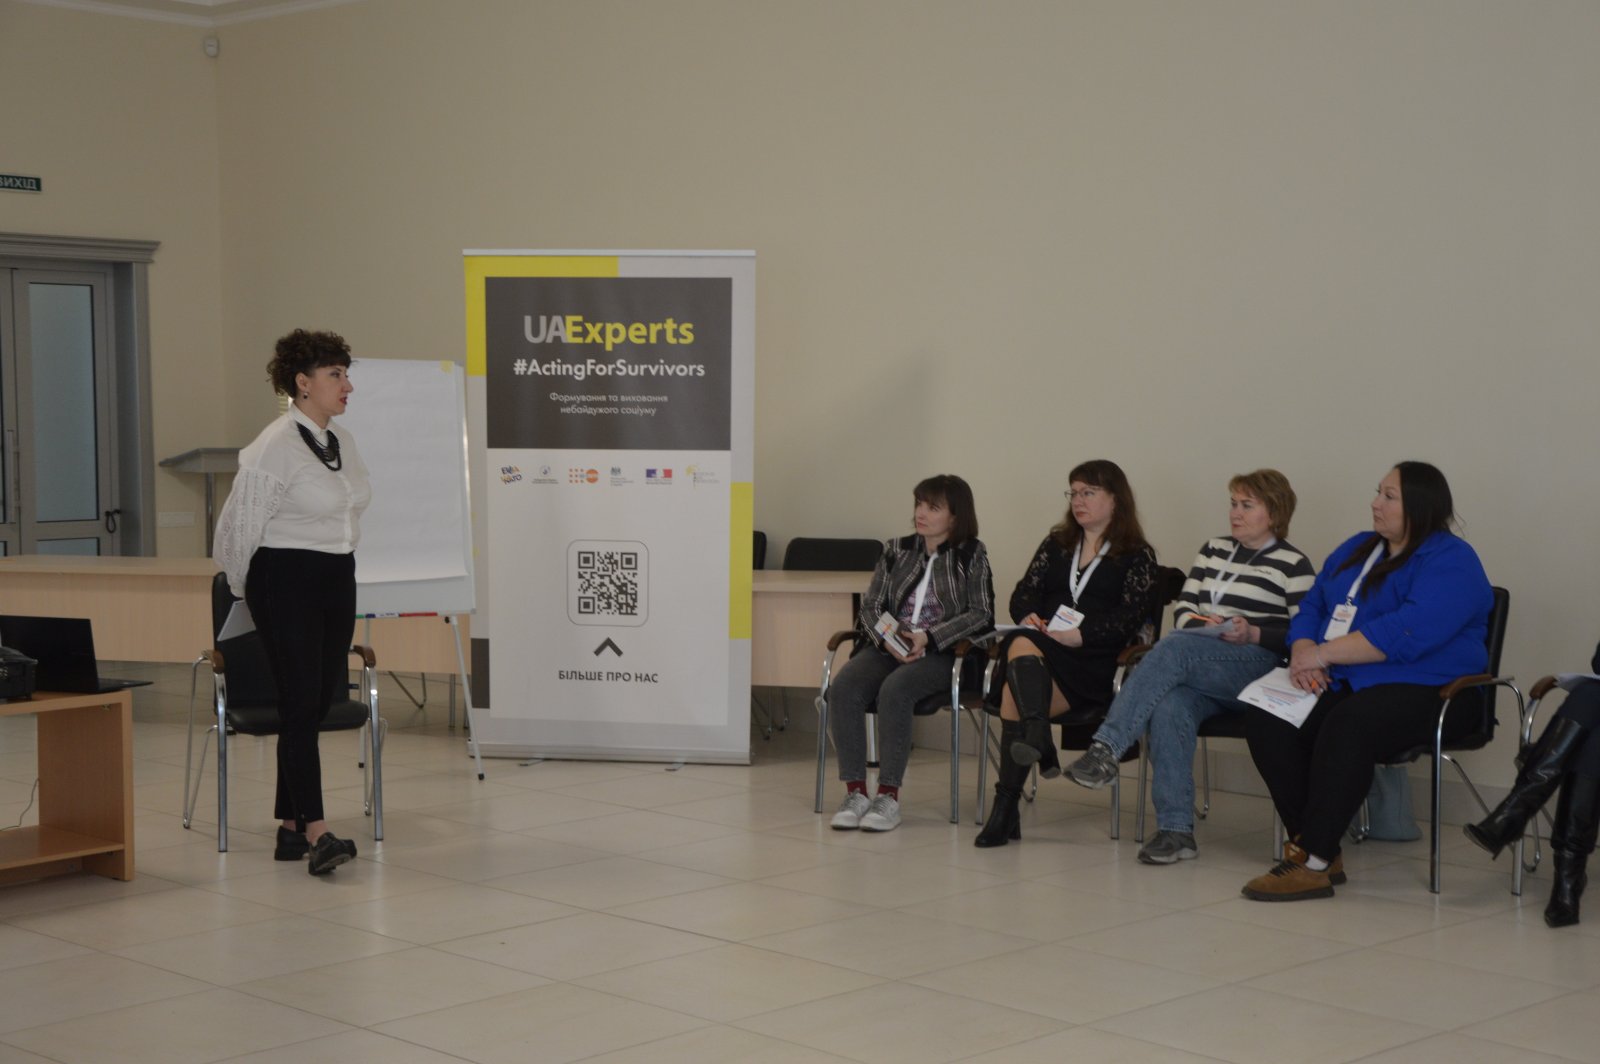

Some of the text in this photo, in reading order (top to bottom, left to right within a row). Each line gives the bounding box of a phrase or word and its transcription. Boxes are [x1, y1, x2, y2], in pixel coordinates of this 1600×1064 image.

[523, 315, 695, 351] UAExperts
[513, 359, 706, 381] #ActingForSurvivors
[549, 392, 669, 403] Формування та виховання
[560, 404, 657, 416] небайдужого соціуму
[558, 670, 659, 683] БІЛЬШЕ ПРО НАС
